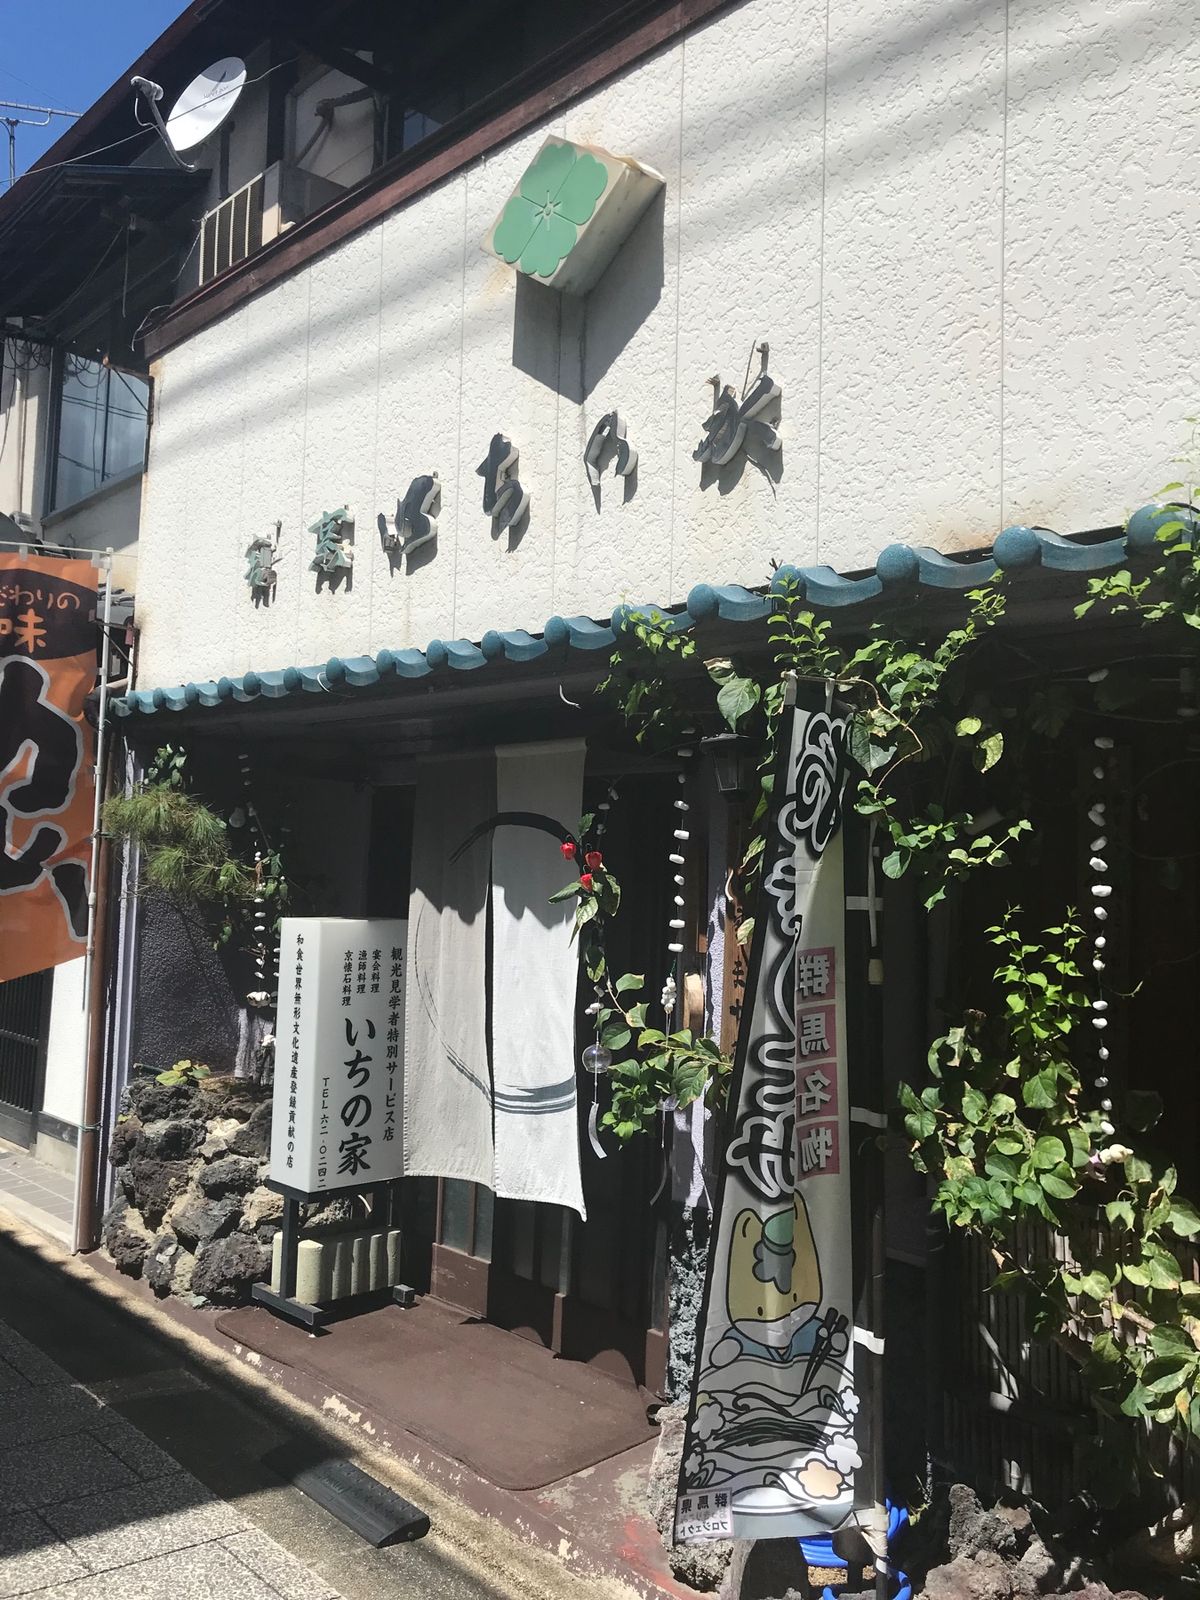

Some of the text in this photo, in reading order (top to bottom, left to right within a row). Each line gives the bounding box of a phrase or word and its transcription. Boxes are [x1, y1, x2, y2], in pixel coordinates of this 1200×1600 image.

[341, 950, 354, 1007] 京懐石料理
[356, 949, 368, 994] 漁師料理
[370, 949, 382, 993] 宴会料理
[382, 946, 404, 1142] 観光見学者特別サービス店
[336, 1016, 377, 1177] いちの家
